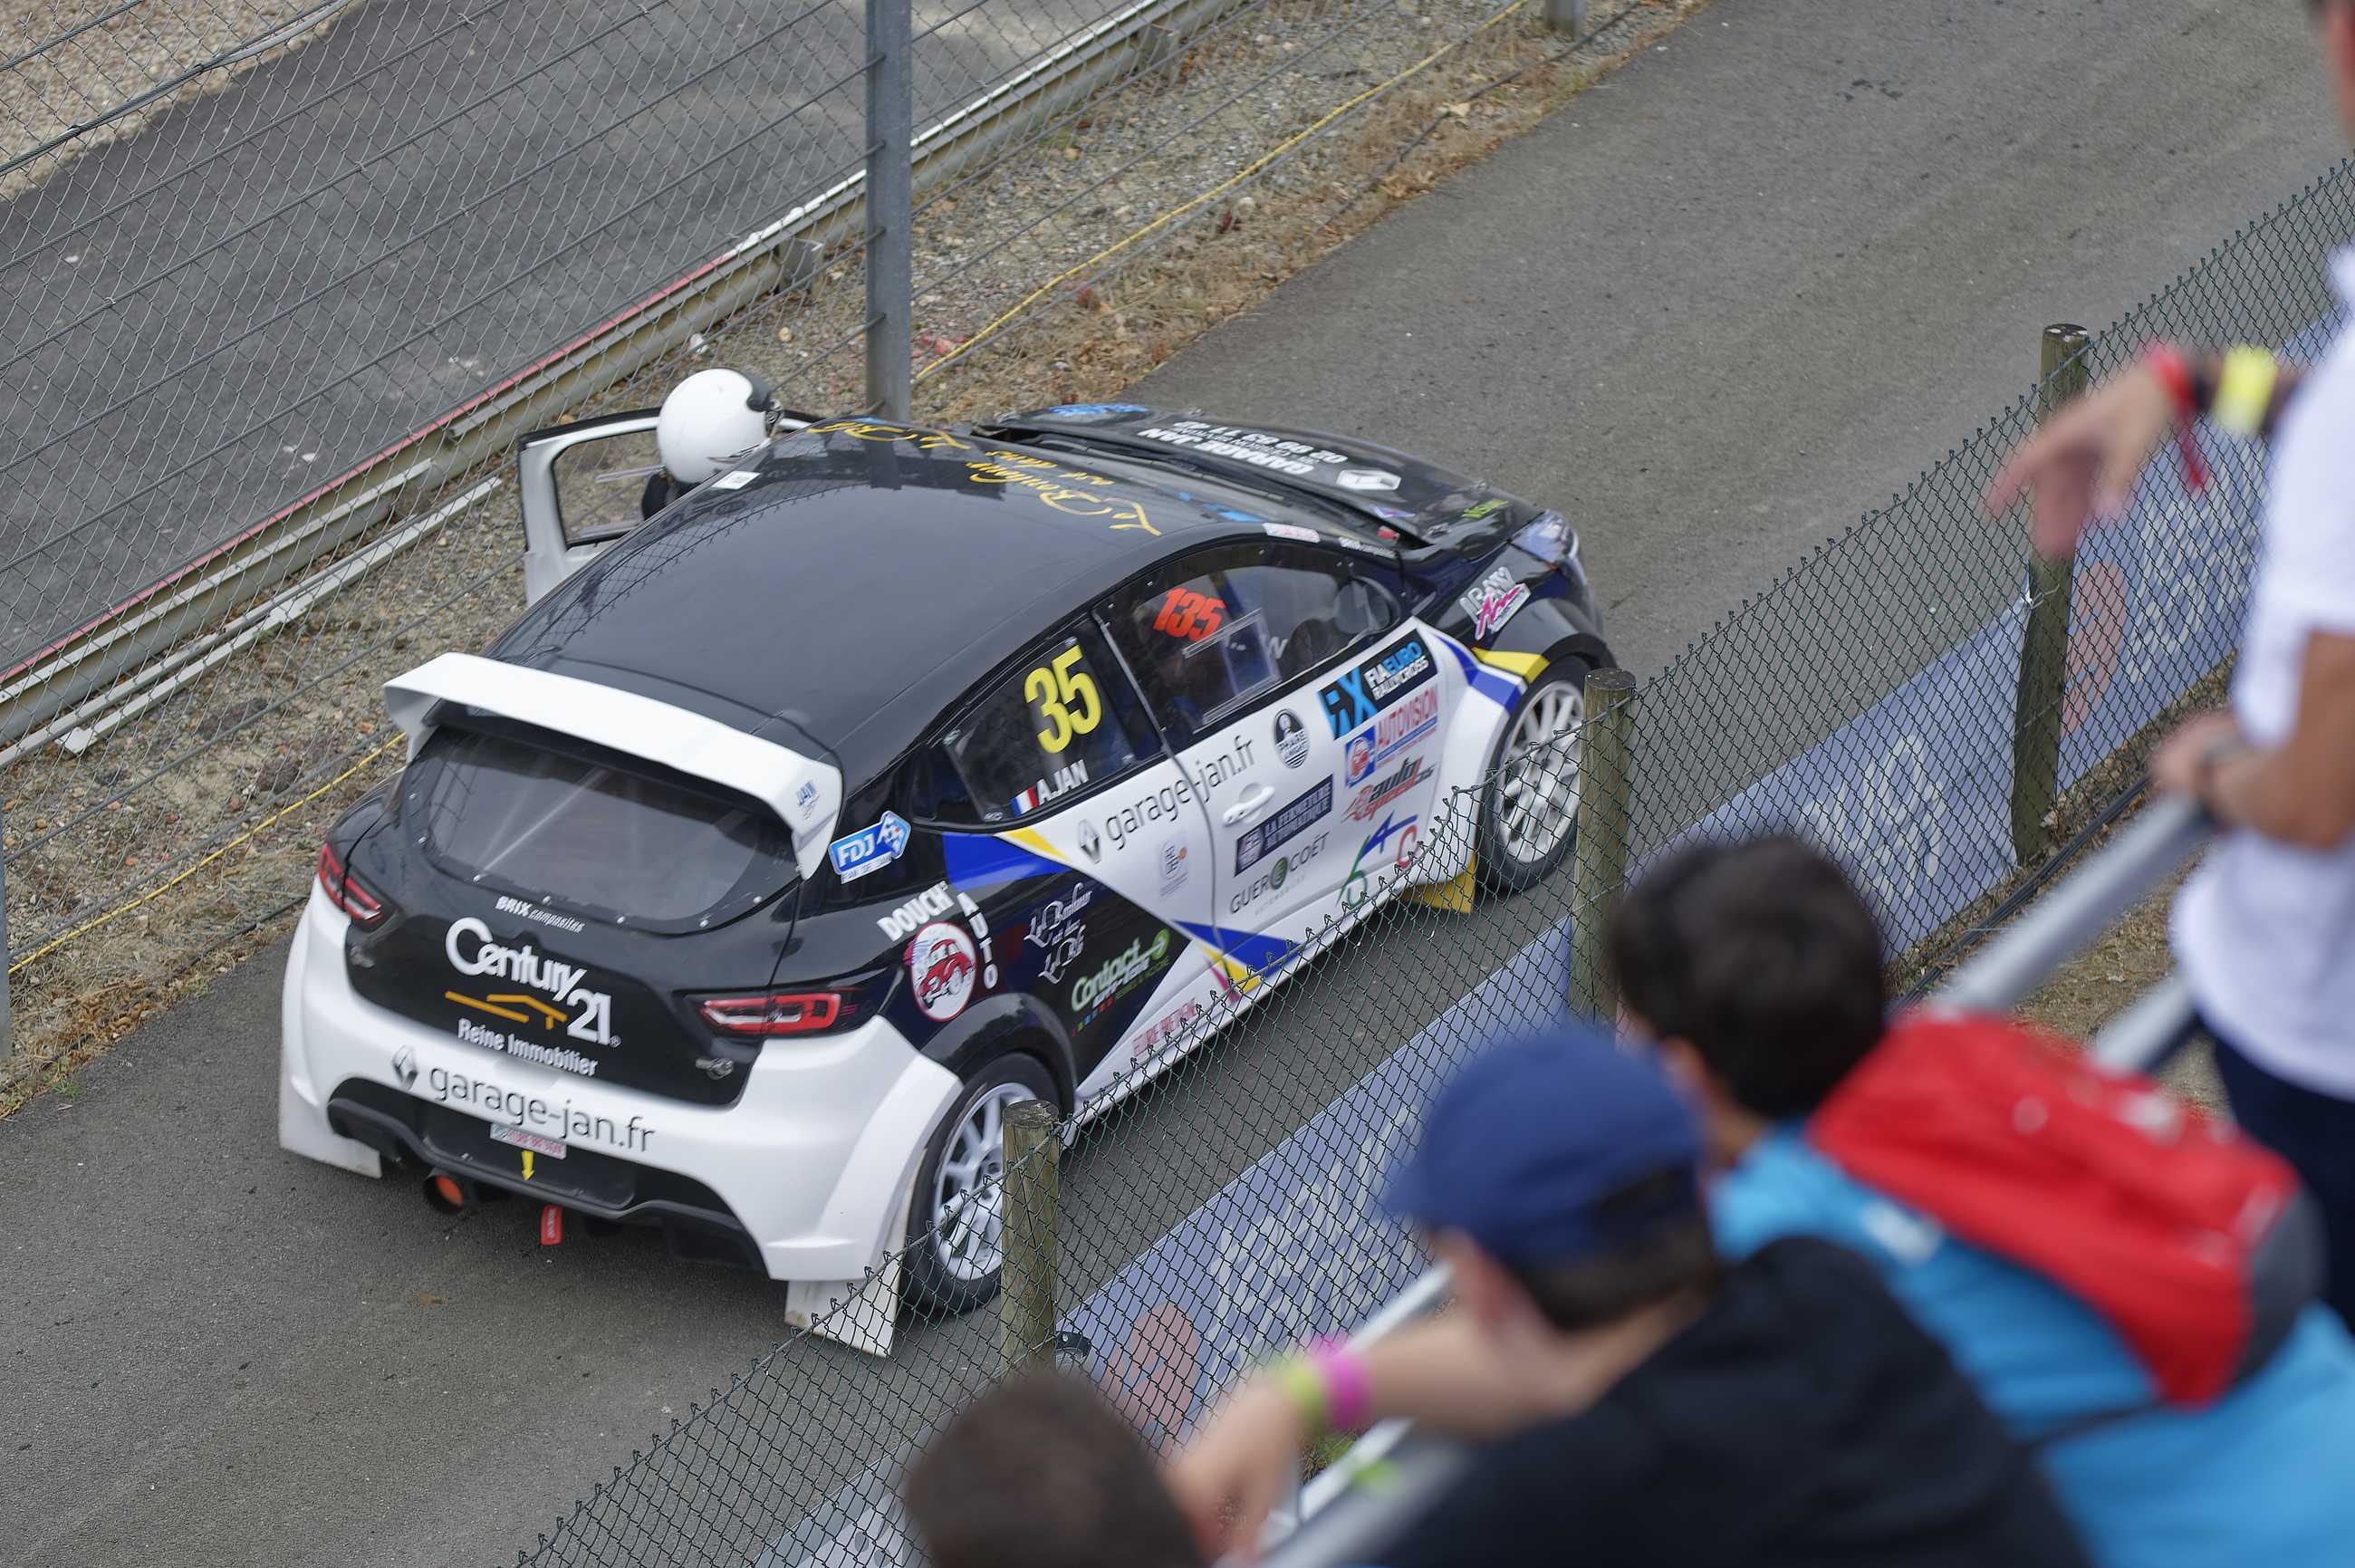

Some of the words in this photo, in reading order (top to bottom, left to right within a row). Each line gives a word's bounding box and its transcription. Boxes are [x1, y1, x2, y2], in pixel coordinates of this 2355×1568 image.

[1193, 439, 1315, 476] GARAGE
[1153, 587, 1226, 642] 135
[1024, 644, 1102, 755] 35
[1105, 735, 1255, 851] garage-jan.fr
[836, 832, 876, 867] FDJ
[495, 895, 533, 918] BRIX
[527, 909, 586, 934] composites
[444, 915, 588, 1003] Century
[1072, 937, 1141, 1012] Contact
[566, 987, 612, 1045] 21
[457, 1017, 507, 1053] Reine
[506, 1033, 599, 1077] Immobilier
[428, 1063, 656, 1155] garage-jan.fr
